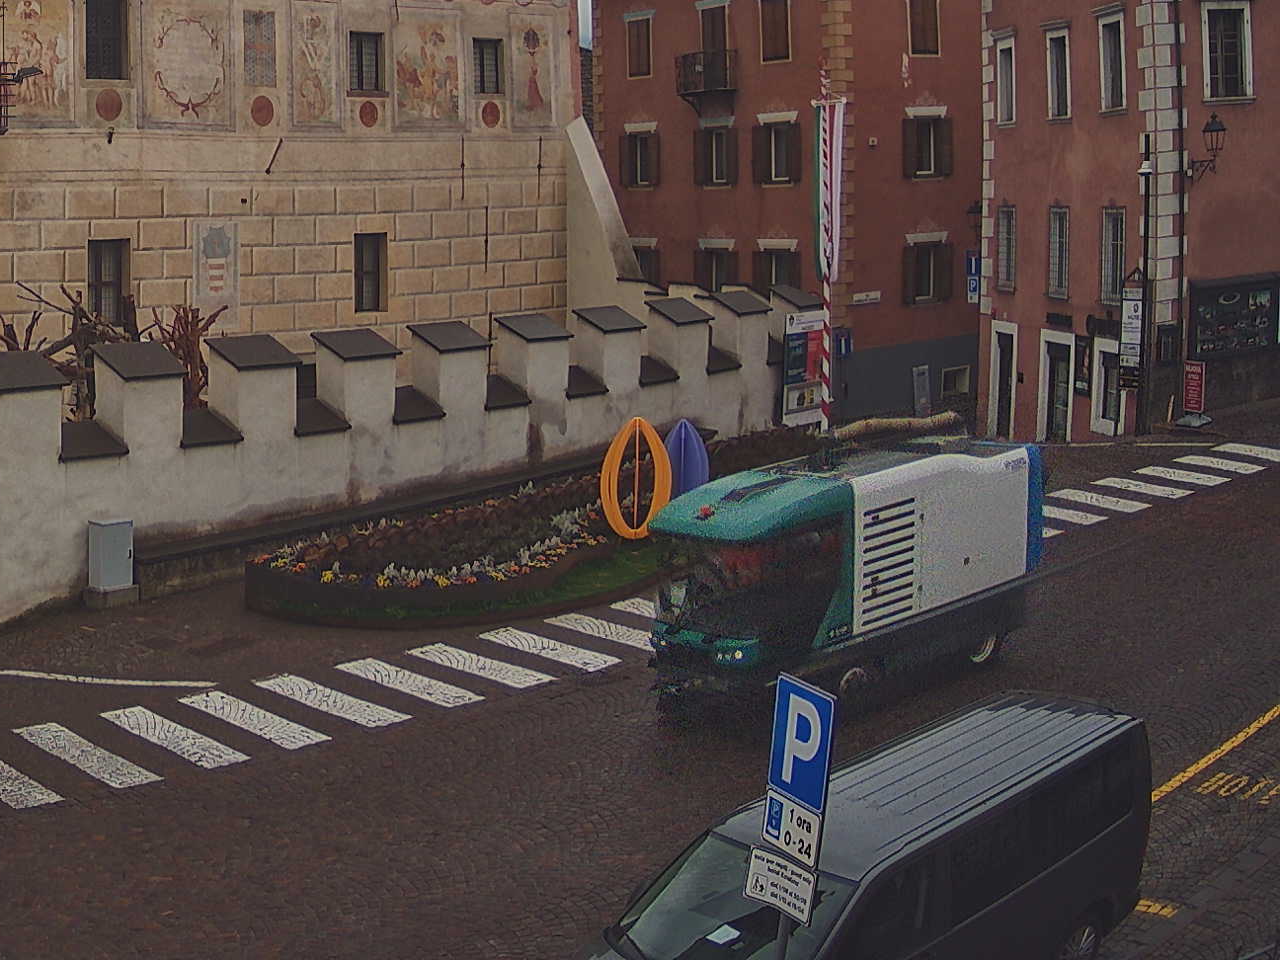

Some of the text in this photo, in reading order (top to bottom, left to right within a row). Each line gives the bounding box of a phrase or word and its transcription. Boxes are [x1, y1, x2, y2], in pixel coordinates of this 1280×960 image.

[781, 692, 821, 784] P
[790, 808, 812, 834] 1 ora
